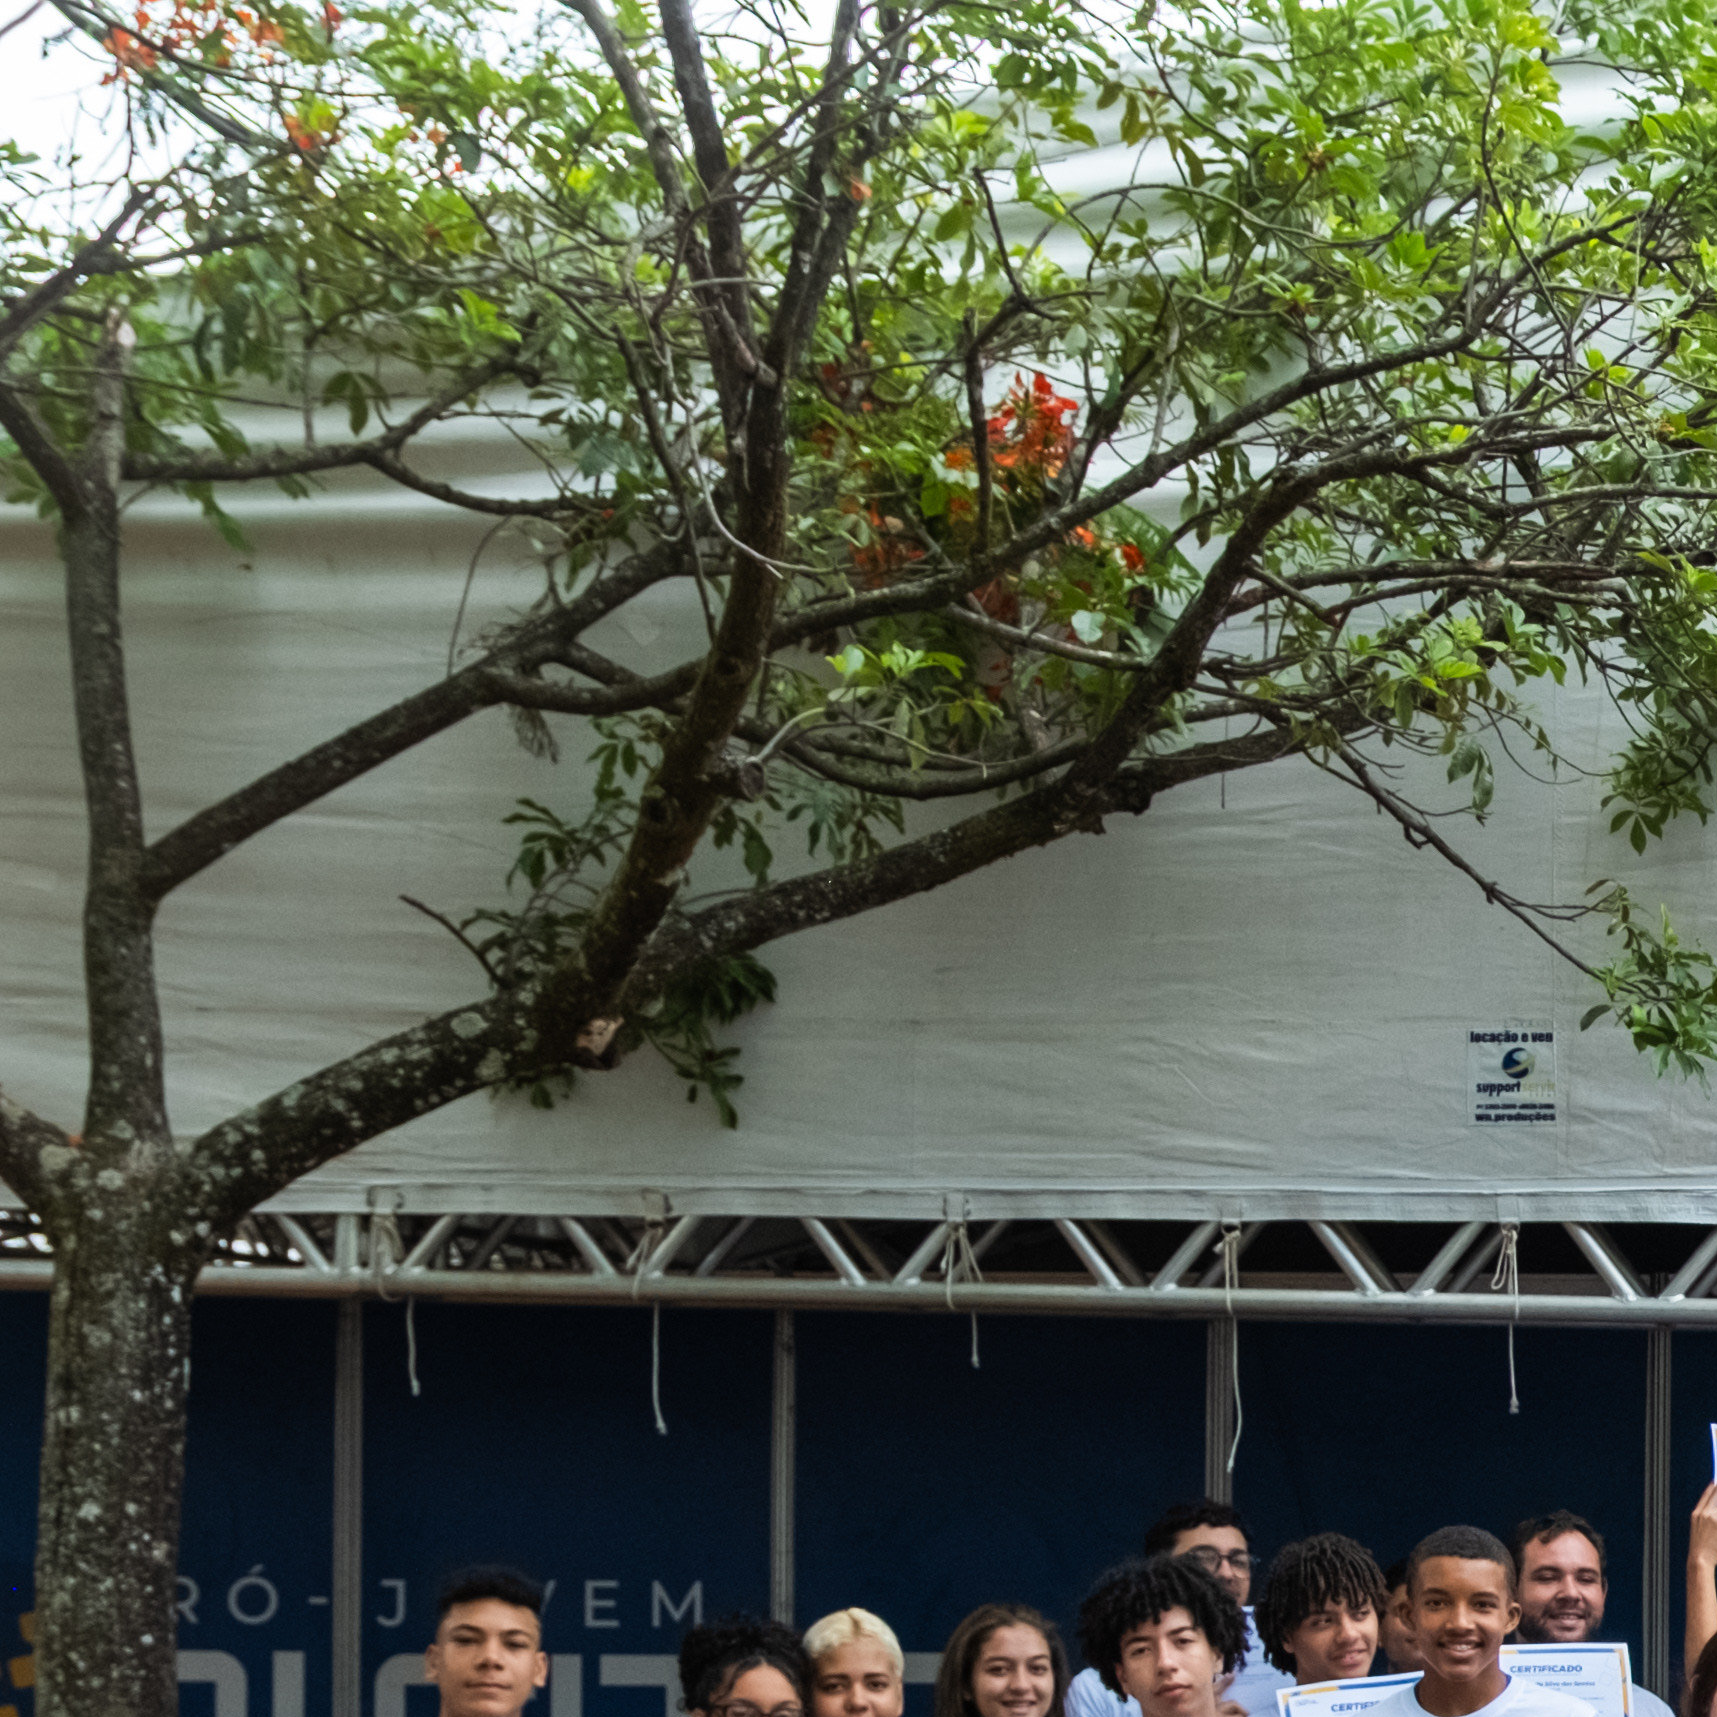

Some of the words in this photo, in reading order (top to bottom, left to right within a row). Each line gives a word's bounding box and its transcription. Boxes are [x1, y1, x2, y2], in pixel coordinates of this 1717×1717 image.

[1470, 1030, 1518, 1045] locação
[1521, 1033, 1529, 1042] e
[1476, 1081, 1521, 1097] support
[173, 1565, 705, 1630] RÓ-JEM
[1510, 1664, 1583, 1674] CERTIFICADO
[1330, 1700, 1381, 1713] CERTIF
